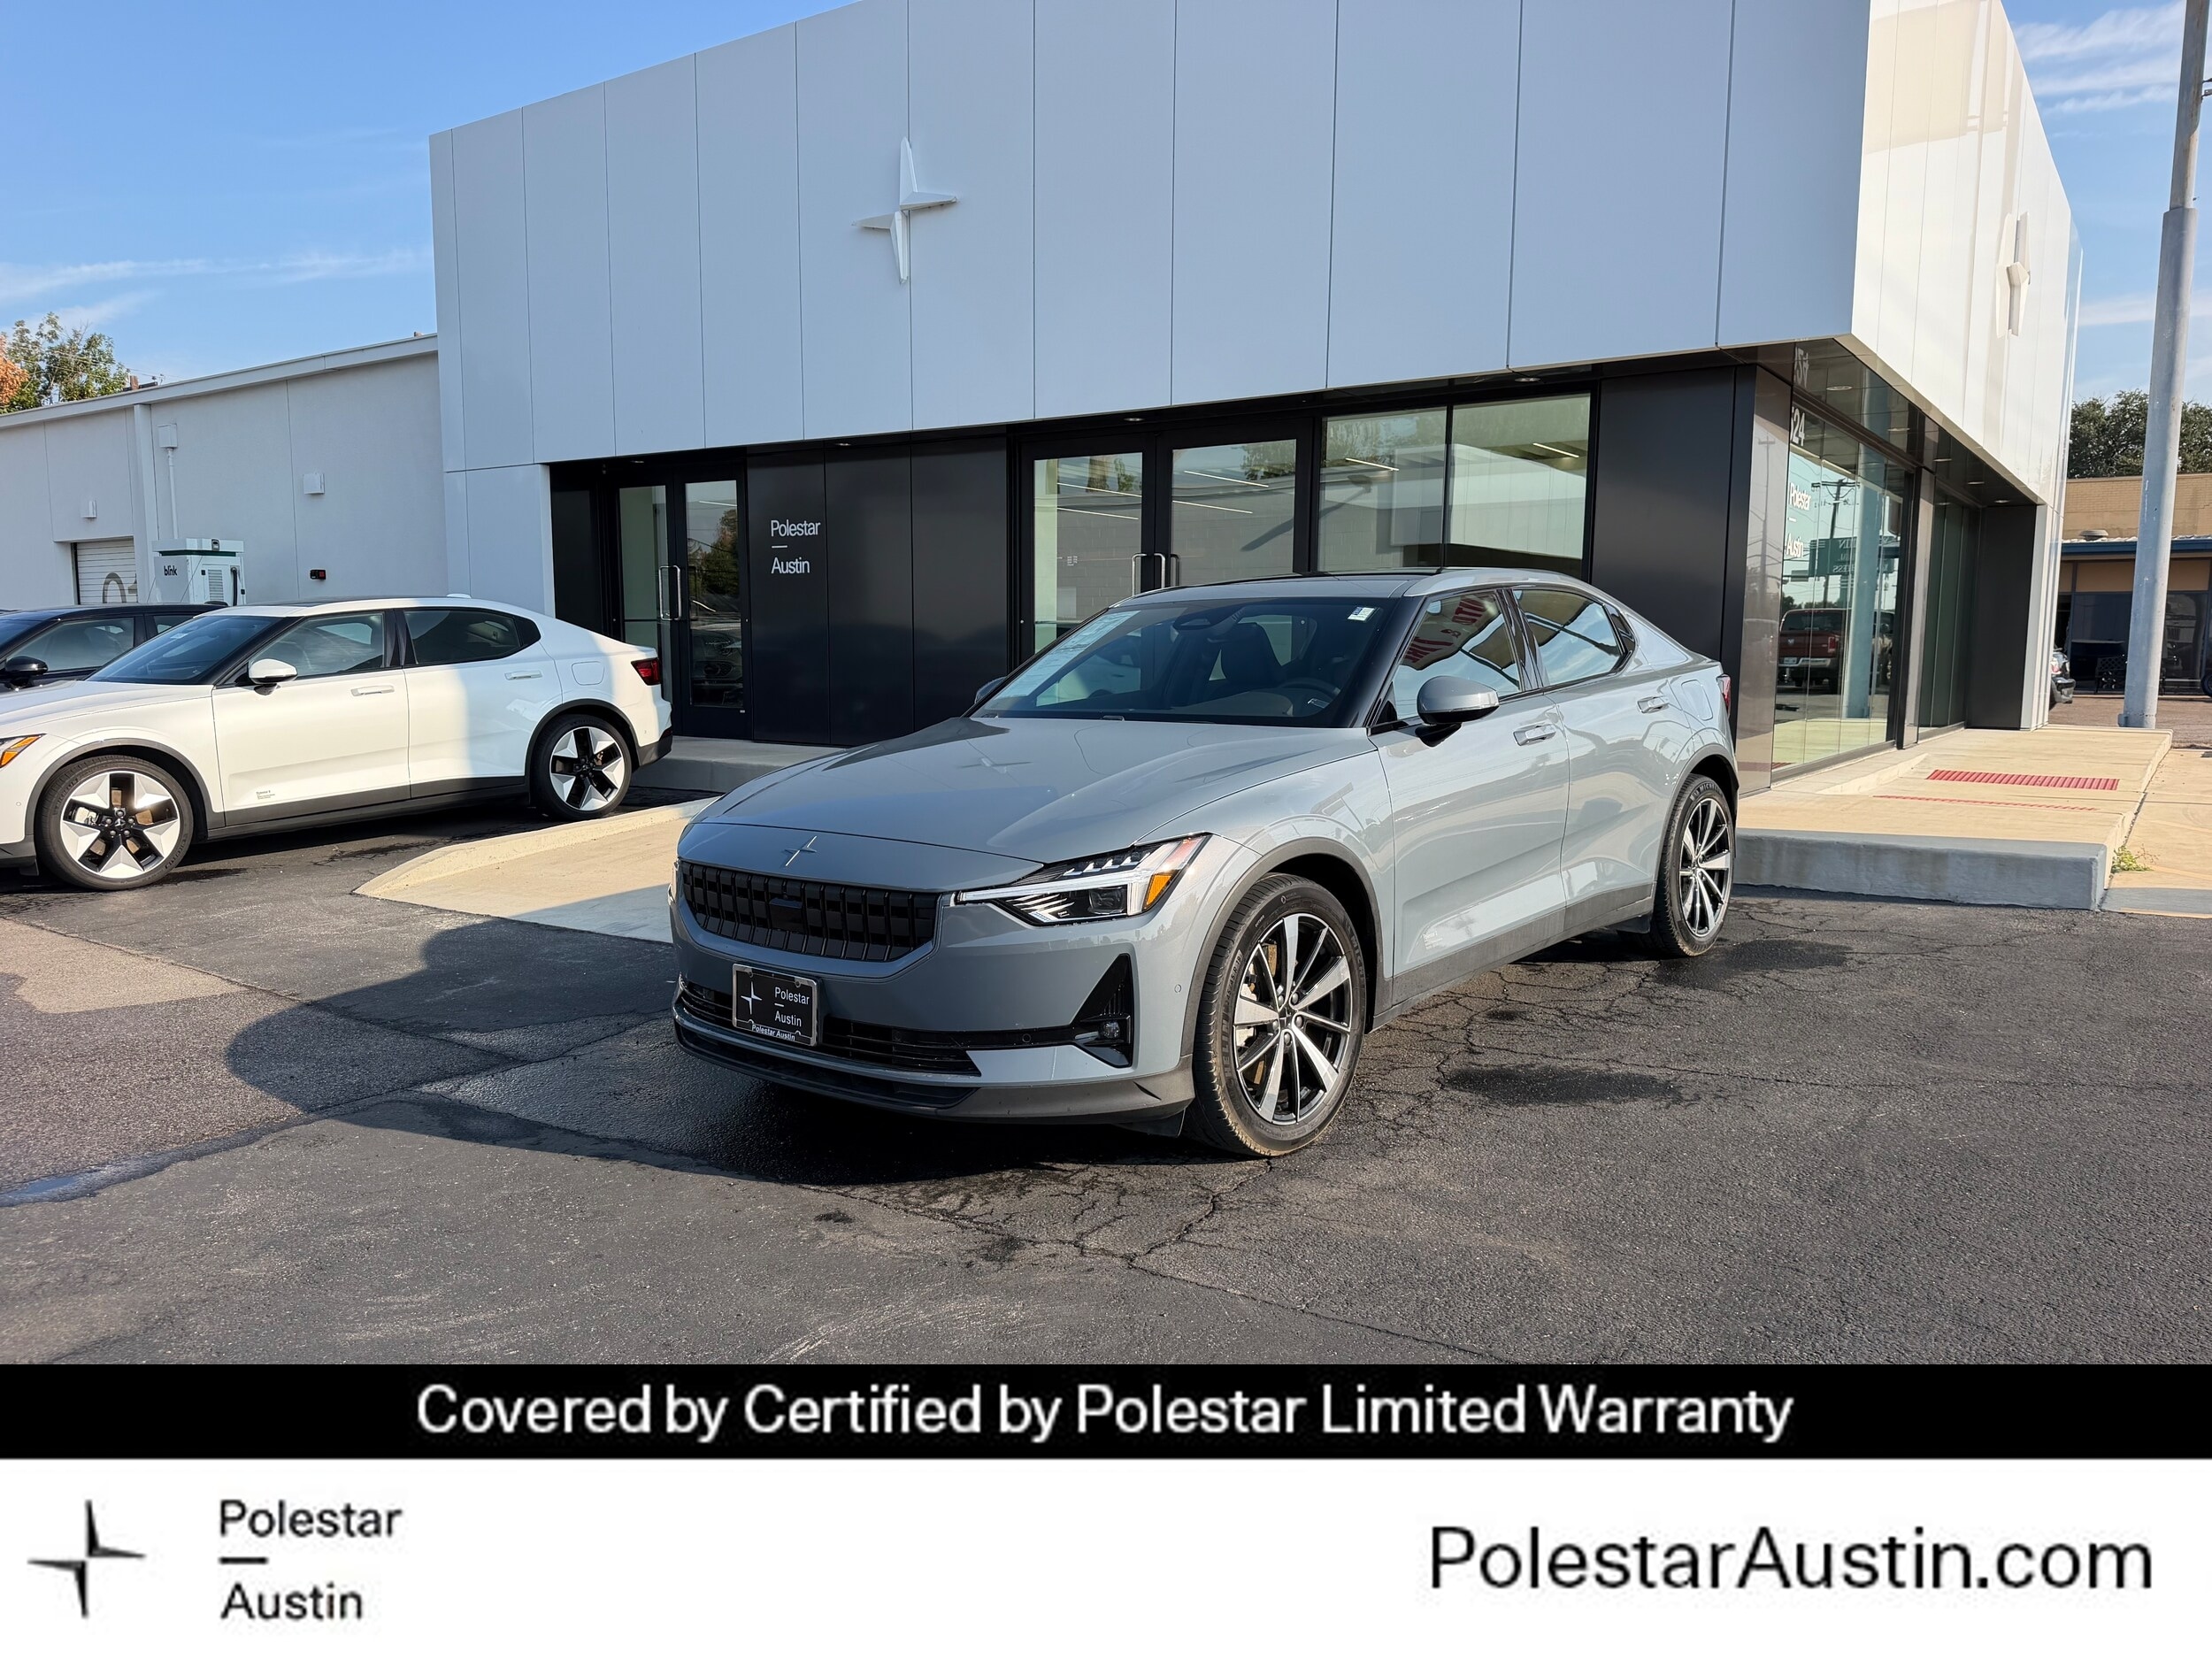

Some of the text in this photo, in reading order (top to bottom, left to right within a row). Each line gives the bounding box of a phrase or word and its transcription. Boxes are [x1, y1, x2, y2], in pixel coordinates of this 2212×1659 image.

[1789, 483, 1812, 511] Polestar
[771, 518, 821, 537] Polestar
[1786, 534, 1804, 558] Austin
[163, 565, 178, 576] blink
[771, 557, 810, 574] Austin
[774, 987, 810, 1005] Polestar
[774, 1010, 803, 1027] Austin
[751, 1024, 795, 1041] Polestar Austin
